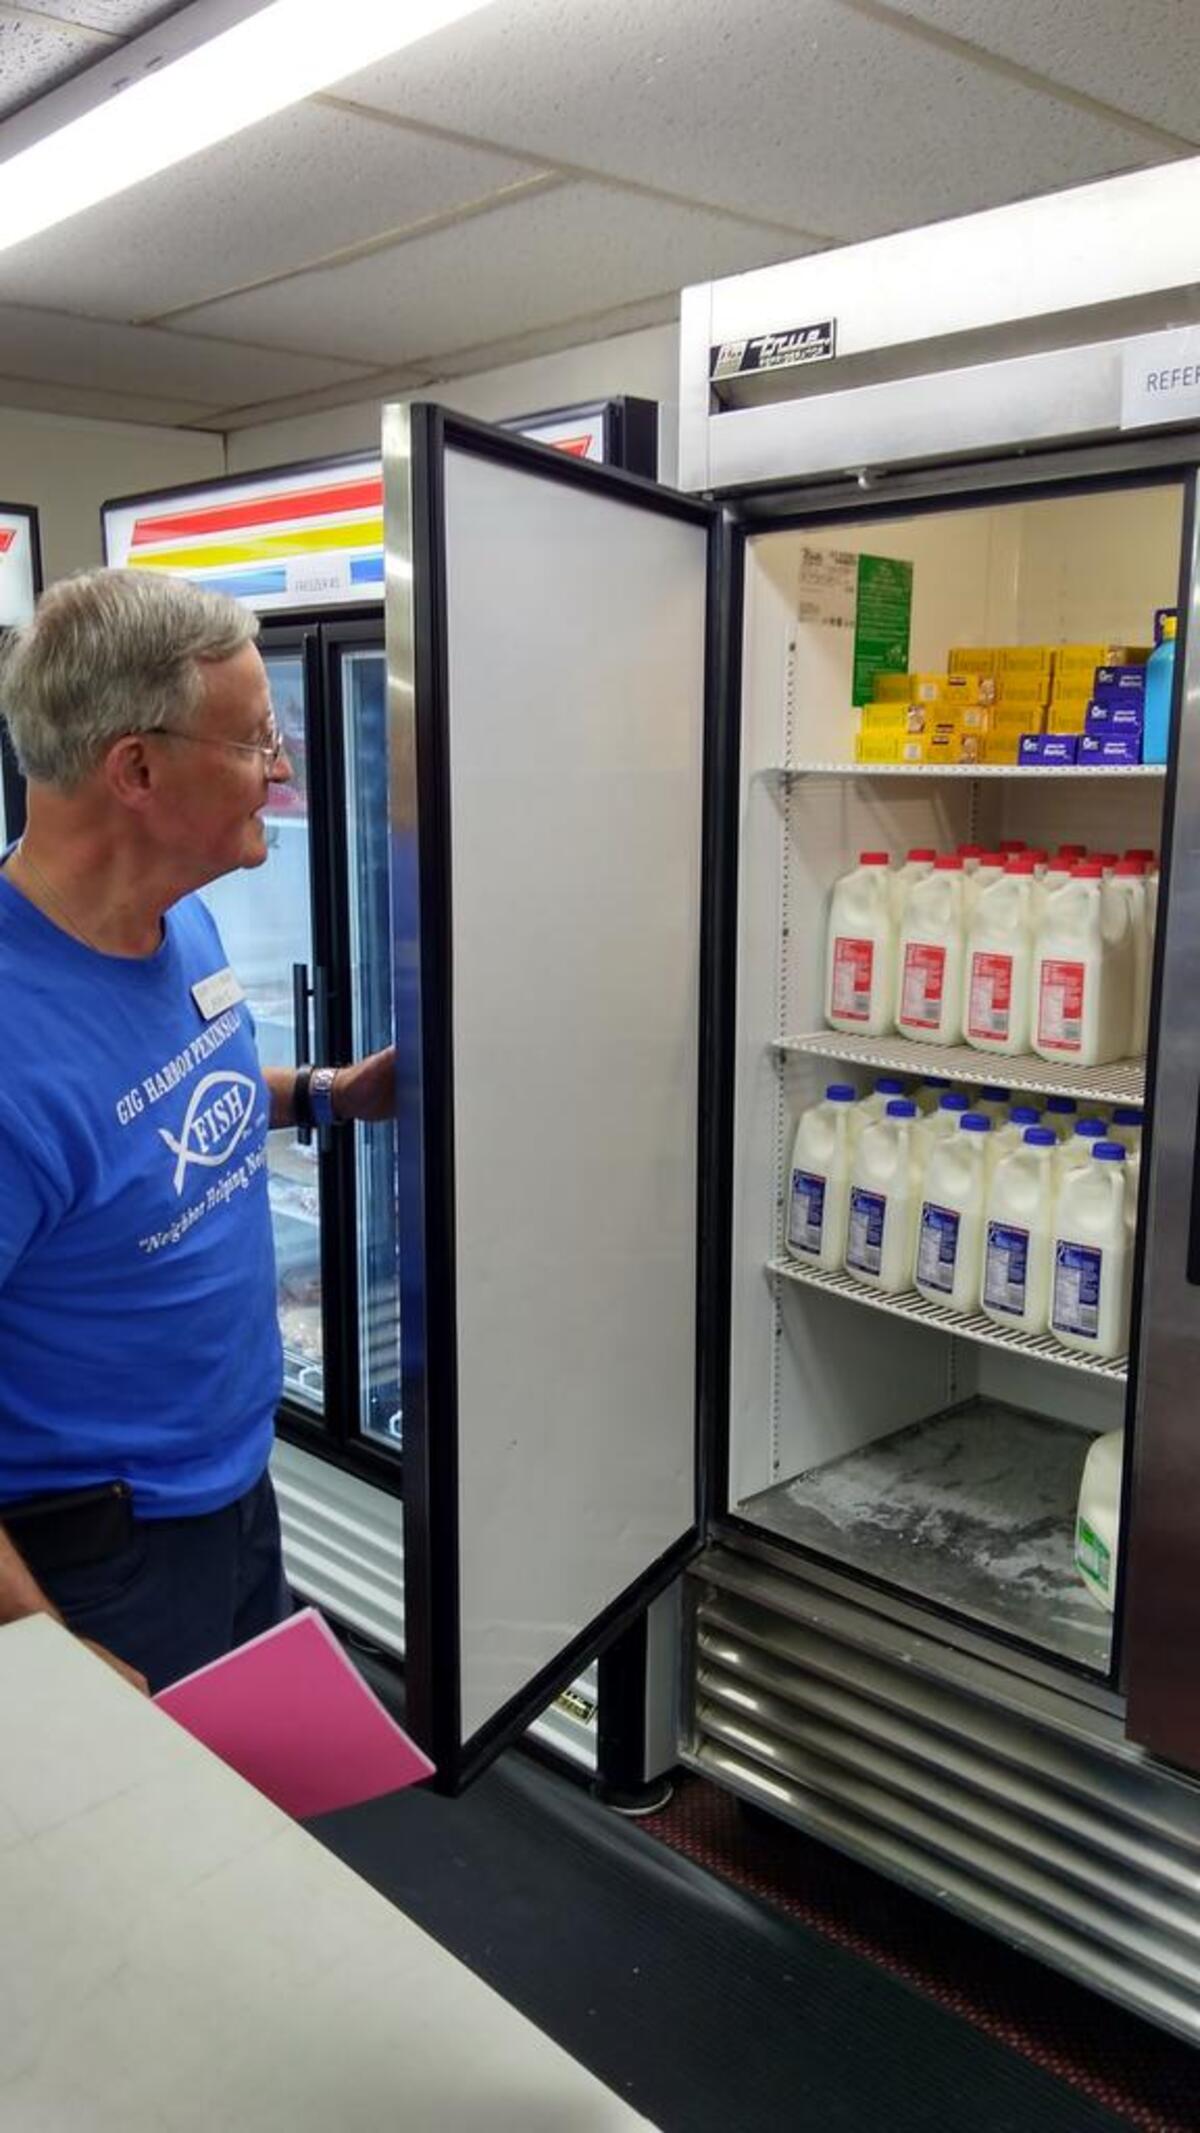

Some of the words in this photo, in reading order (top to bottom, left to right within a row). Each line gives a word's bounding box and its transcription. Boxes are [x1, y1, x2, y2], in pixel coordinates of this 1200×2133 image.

[116, 1088, 144, 1126] GIG
[142, 1049, 194, 1104] HARBOR
[191, 1083, 244, 1153] FISH
[205, 1165, 249, 1211] Helping
